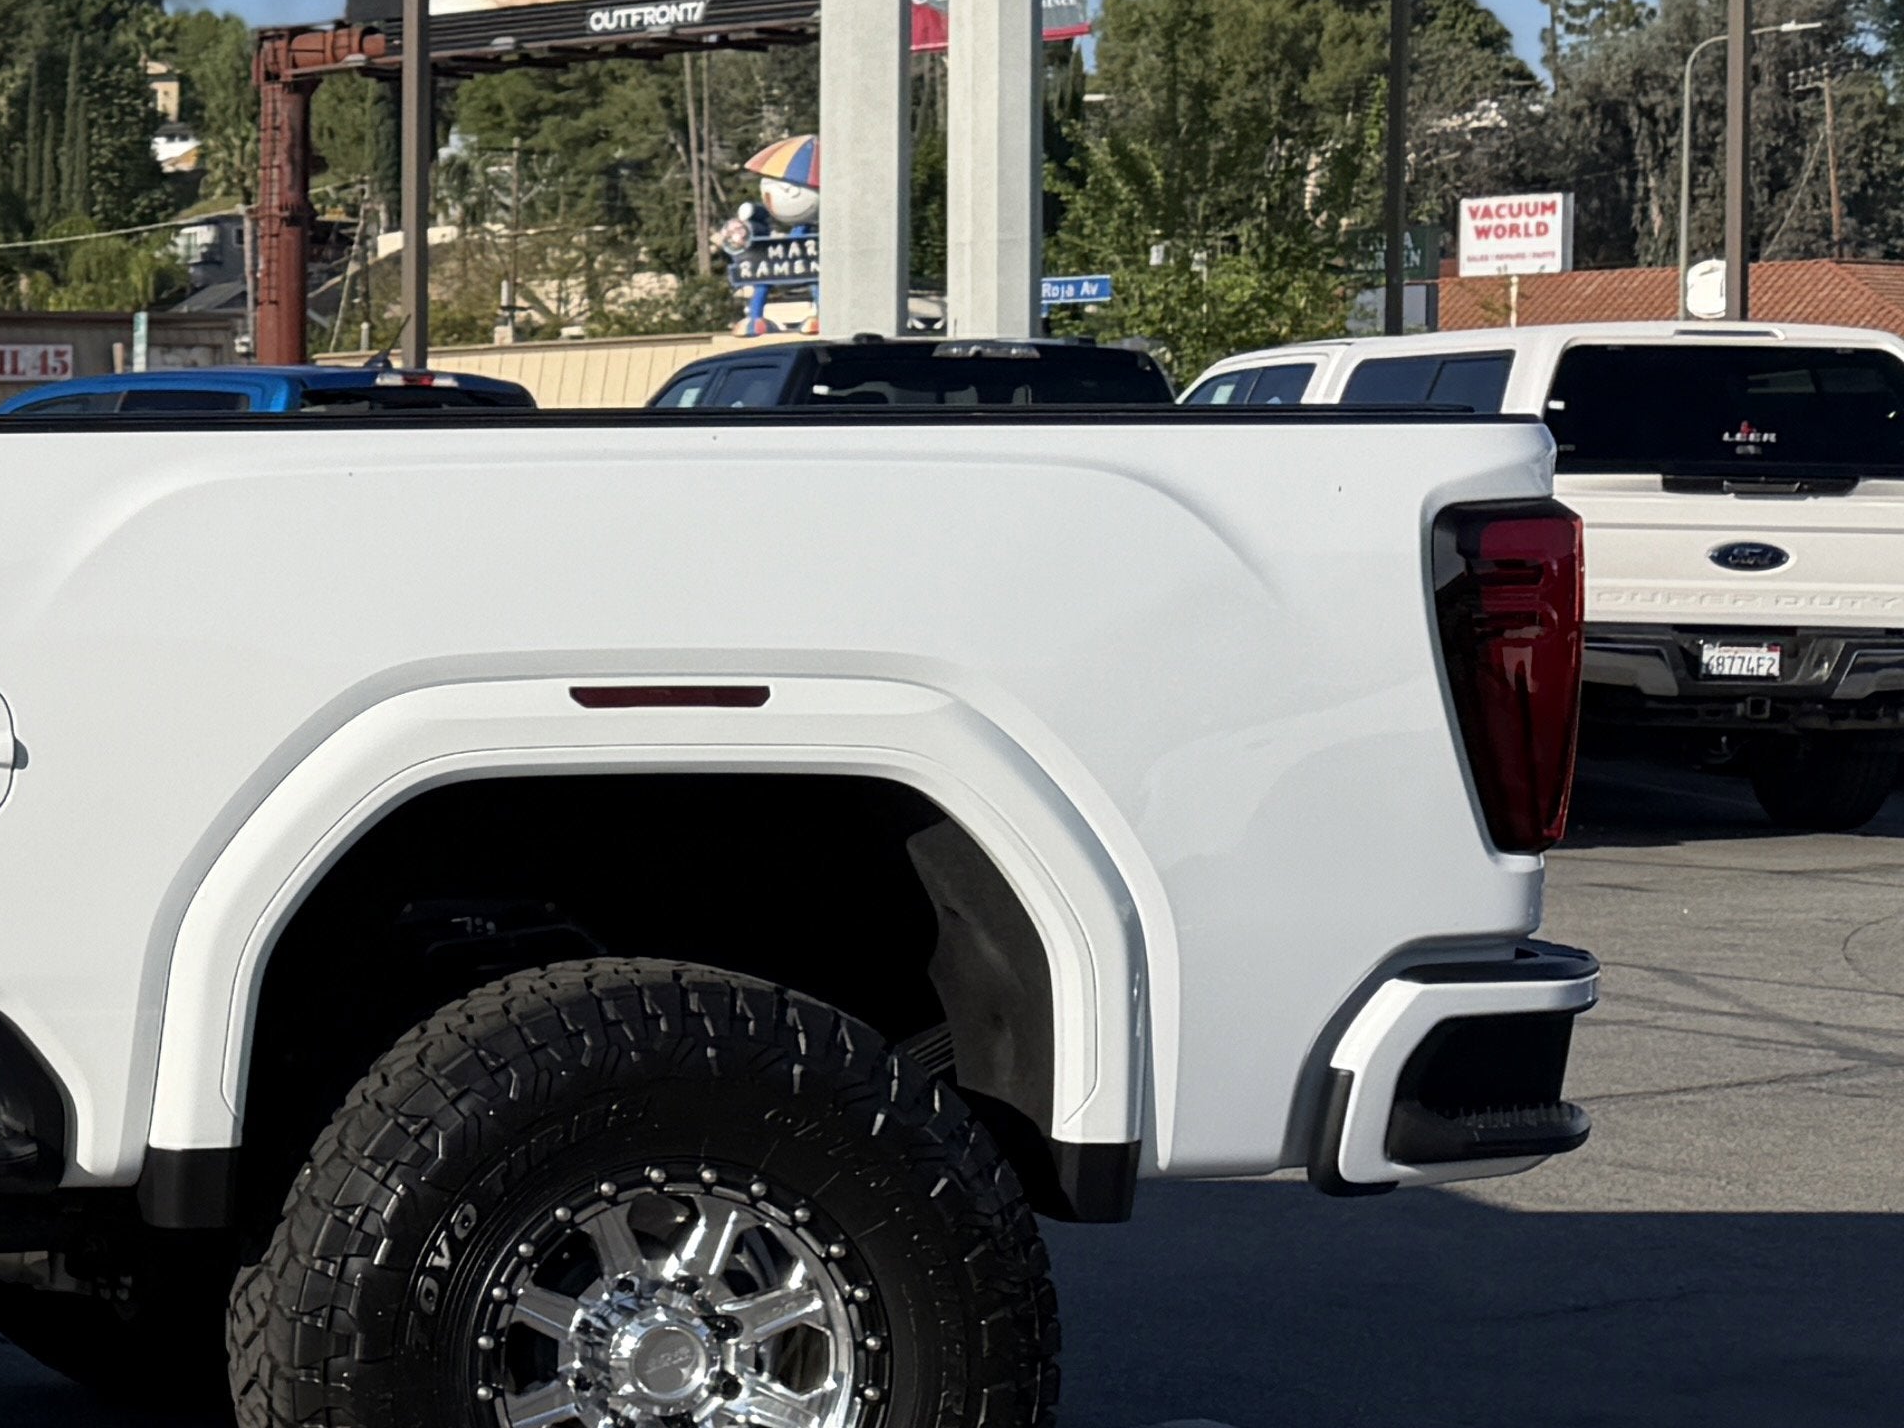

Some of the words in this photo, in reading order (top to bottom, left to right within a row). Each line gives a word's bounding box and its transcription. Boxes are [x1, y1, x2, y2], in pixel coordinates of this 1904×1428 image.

[1468, 200, 1557, 220] VACUUM
[1474, 222, 1549, 240] WORLD
[1080, 281, 1099, 297] Av
[31, 349, 69, 376] 45
